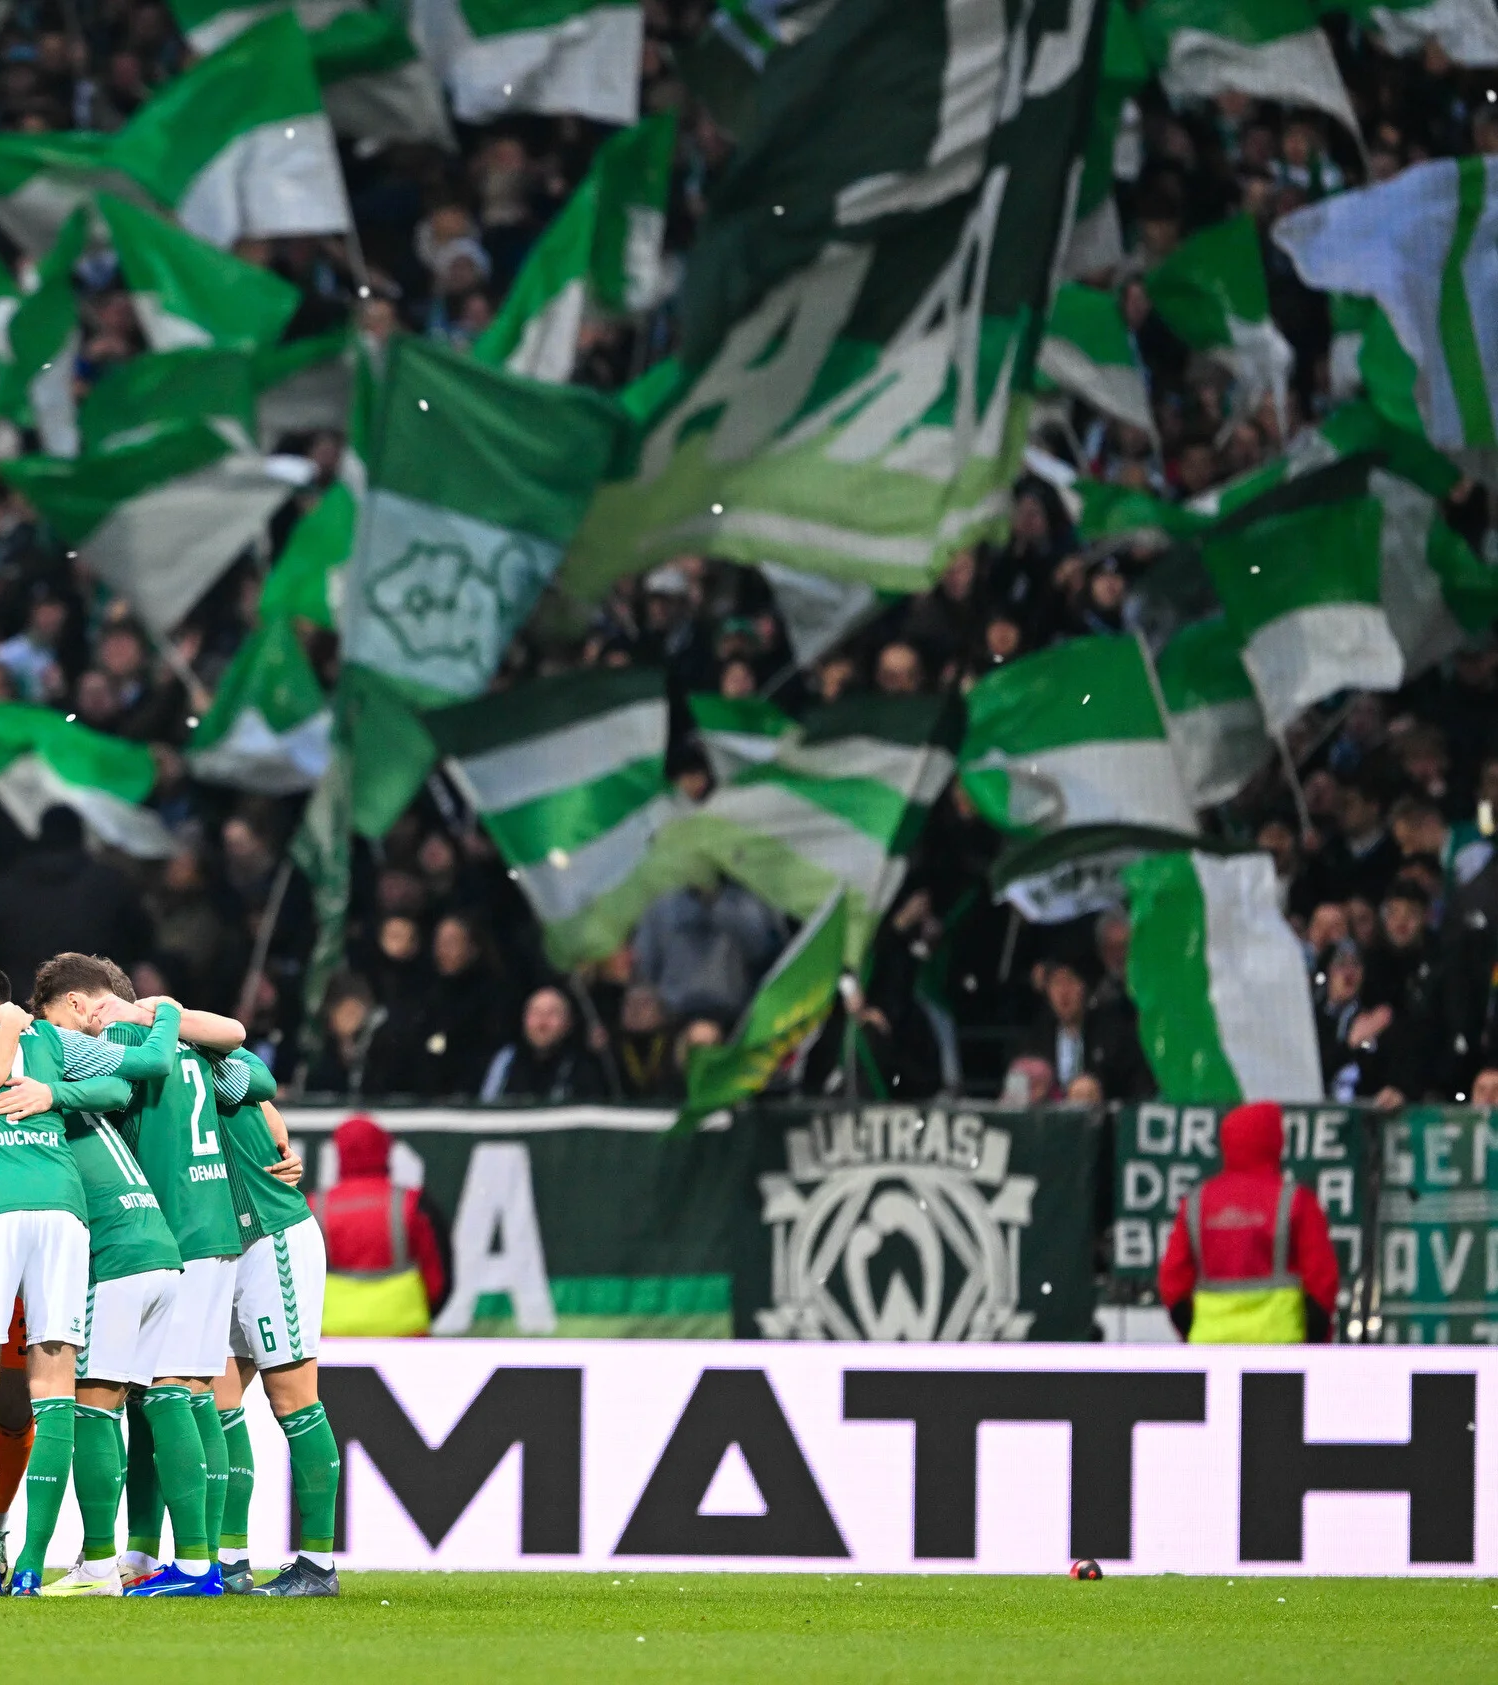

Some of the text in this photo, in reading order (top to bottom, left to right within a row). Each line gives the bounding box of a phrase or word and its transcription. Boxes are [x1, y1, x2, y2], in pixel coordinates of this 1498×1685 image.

[181, 1059, 219, 1156] 2
[812, 1105, 984, 1170] ULTRAS
[258, 1316, 277, 1353] 6
[290, 1366, 1478, 1564] MATTH
